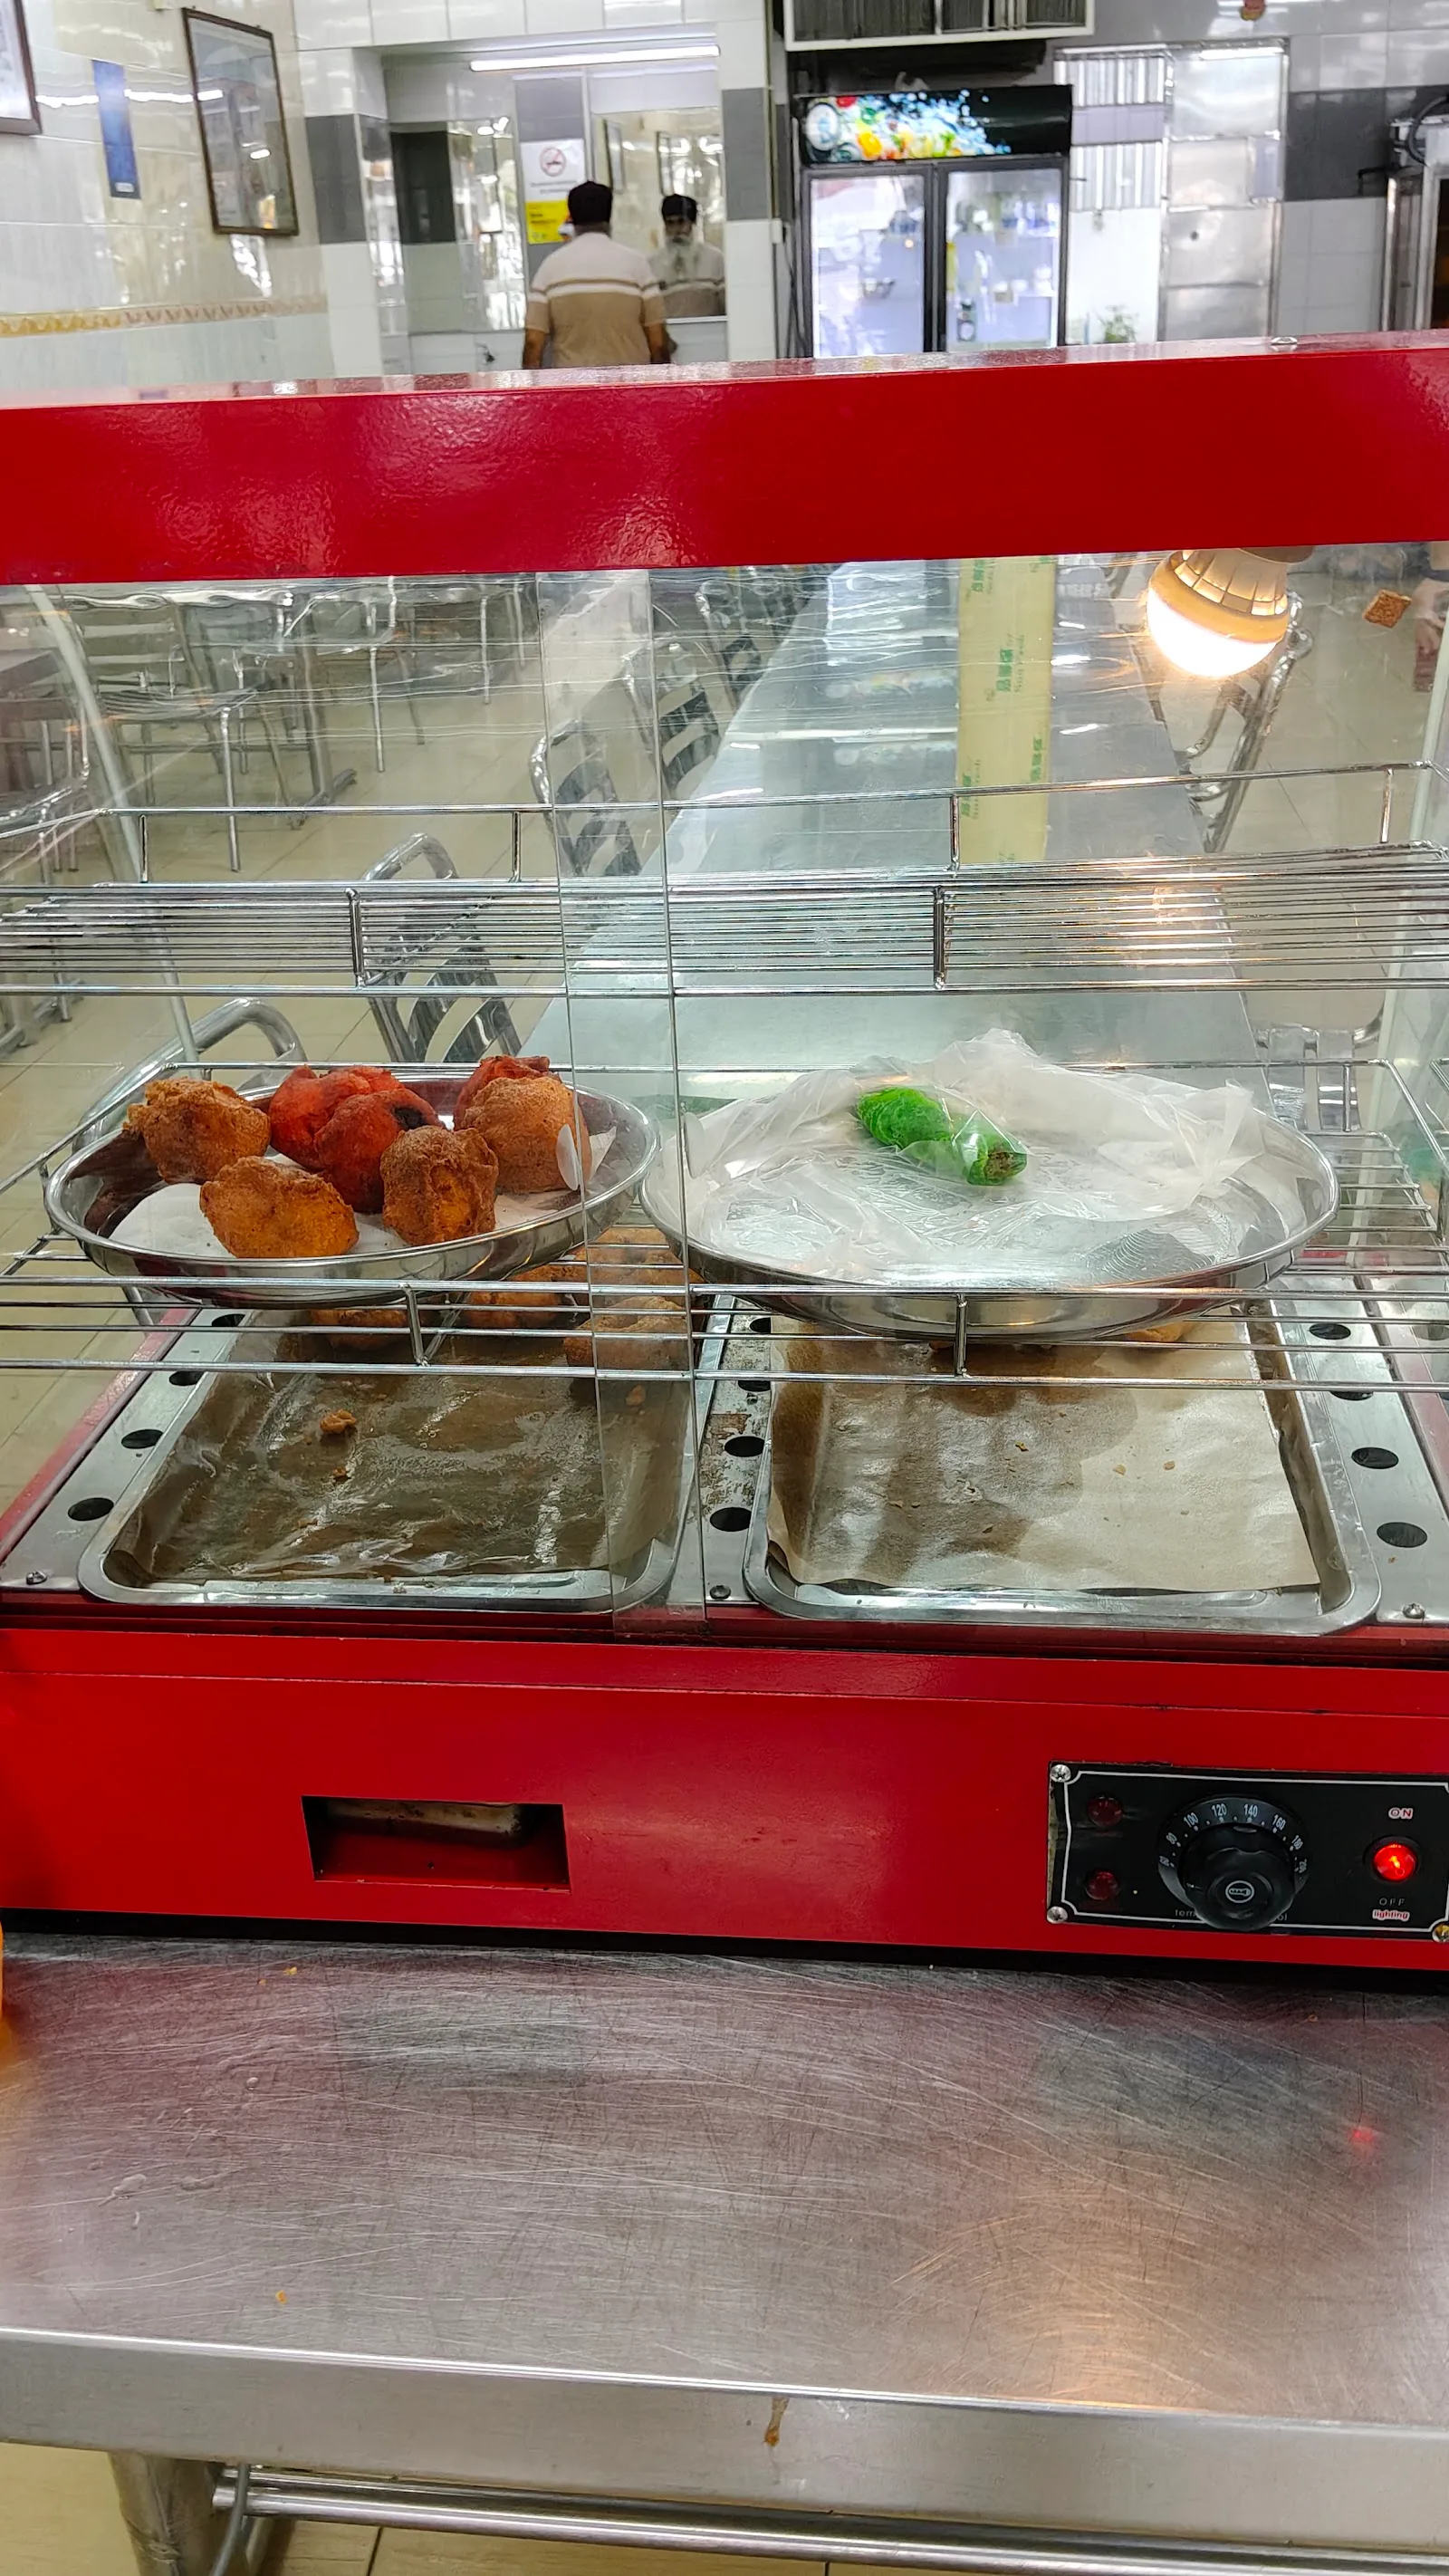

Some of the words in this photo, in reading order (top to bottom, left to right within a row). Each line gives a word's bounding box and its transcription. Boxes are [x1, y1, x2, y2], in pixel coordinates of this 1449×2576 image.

[1388, 1807, 1414, 1819] ON
[1183, 1812, 1199, 1828] 100
[1211, 1802, 1227, 1817] 120
[1243, 1803, 1258, 1818] 140
[1272, 1814, 1286, 1831] 160
[1291, 1835, 1304, 1850] 180
[1378, 1898, 1406, 1907] OFF
[1372, 1909, 1410, 1922] lighting
